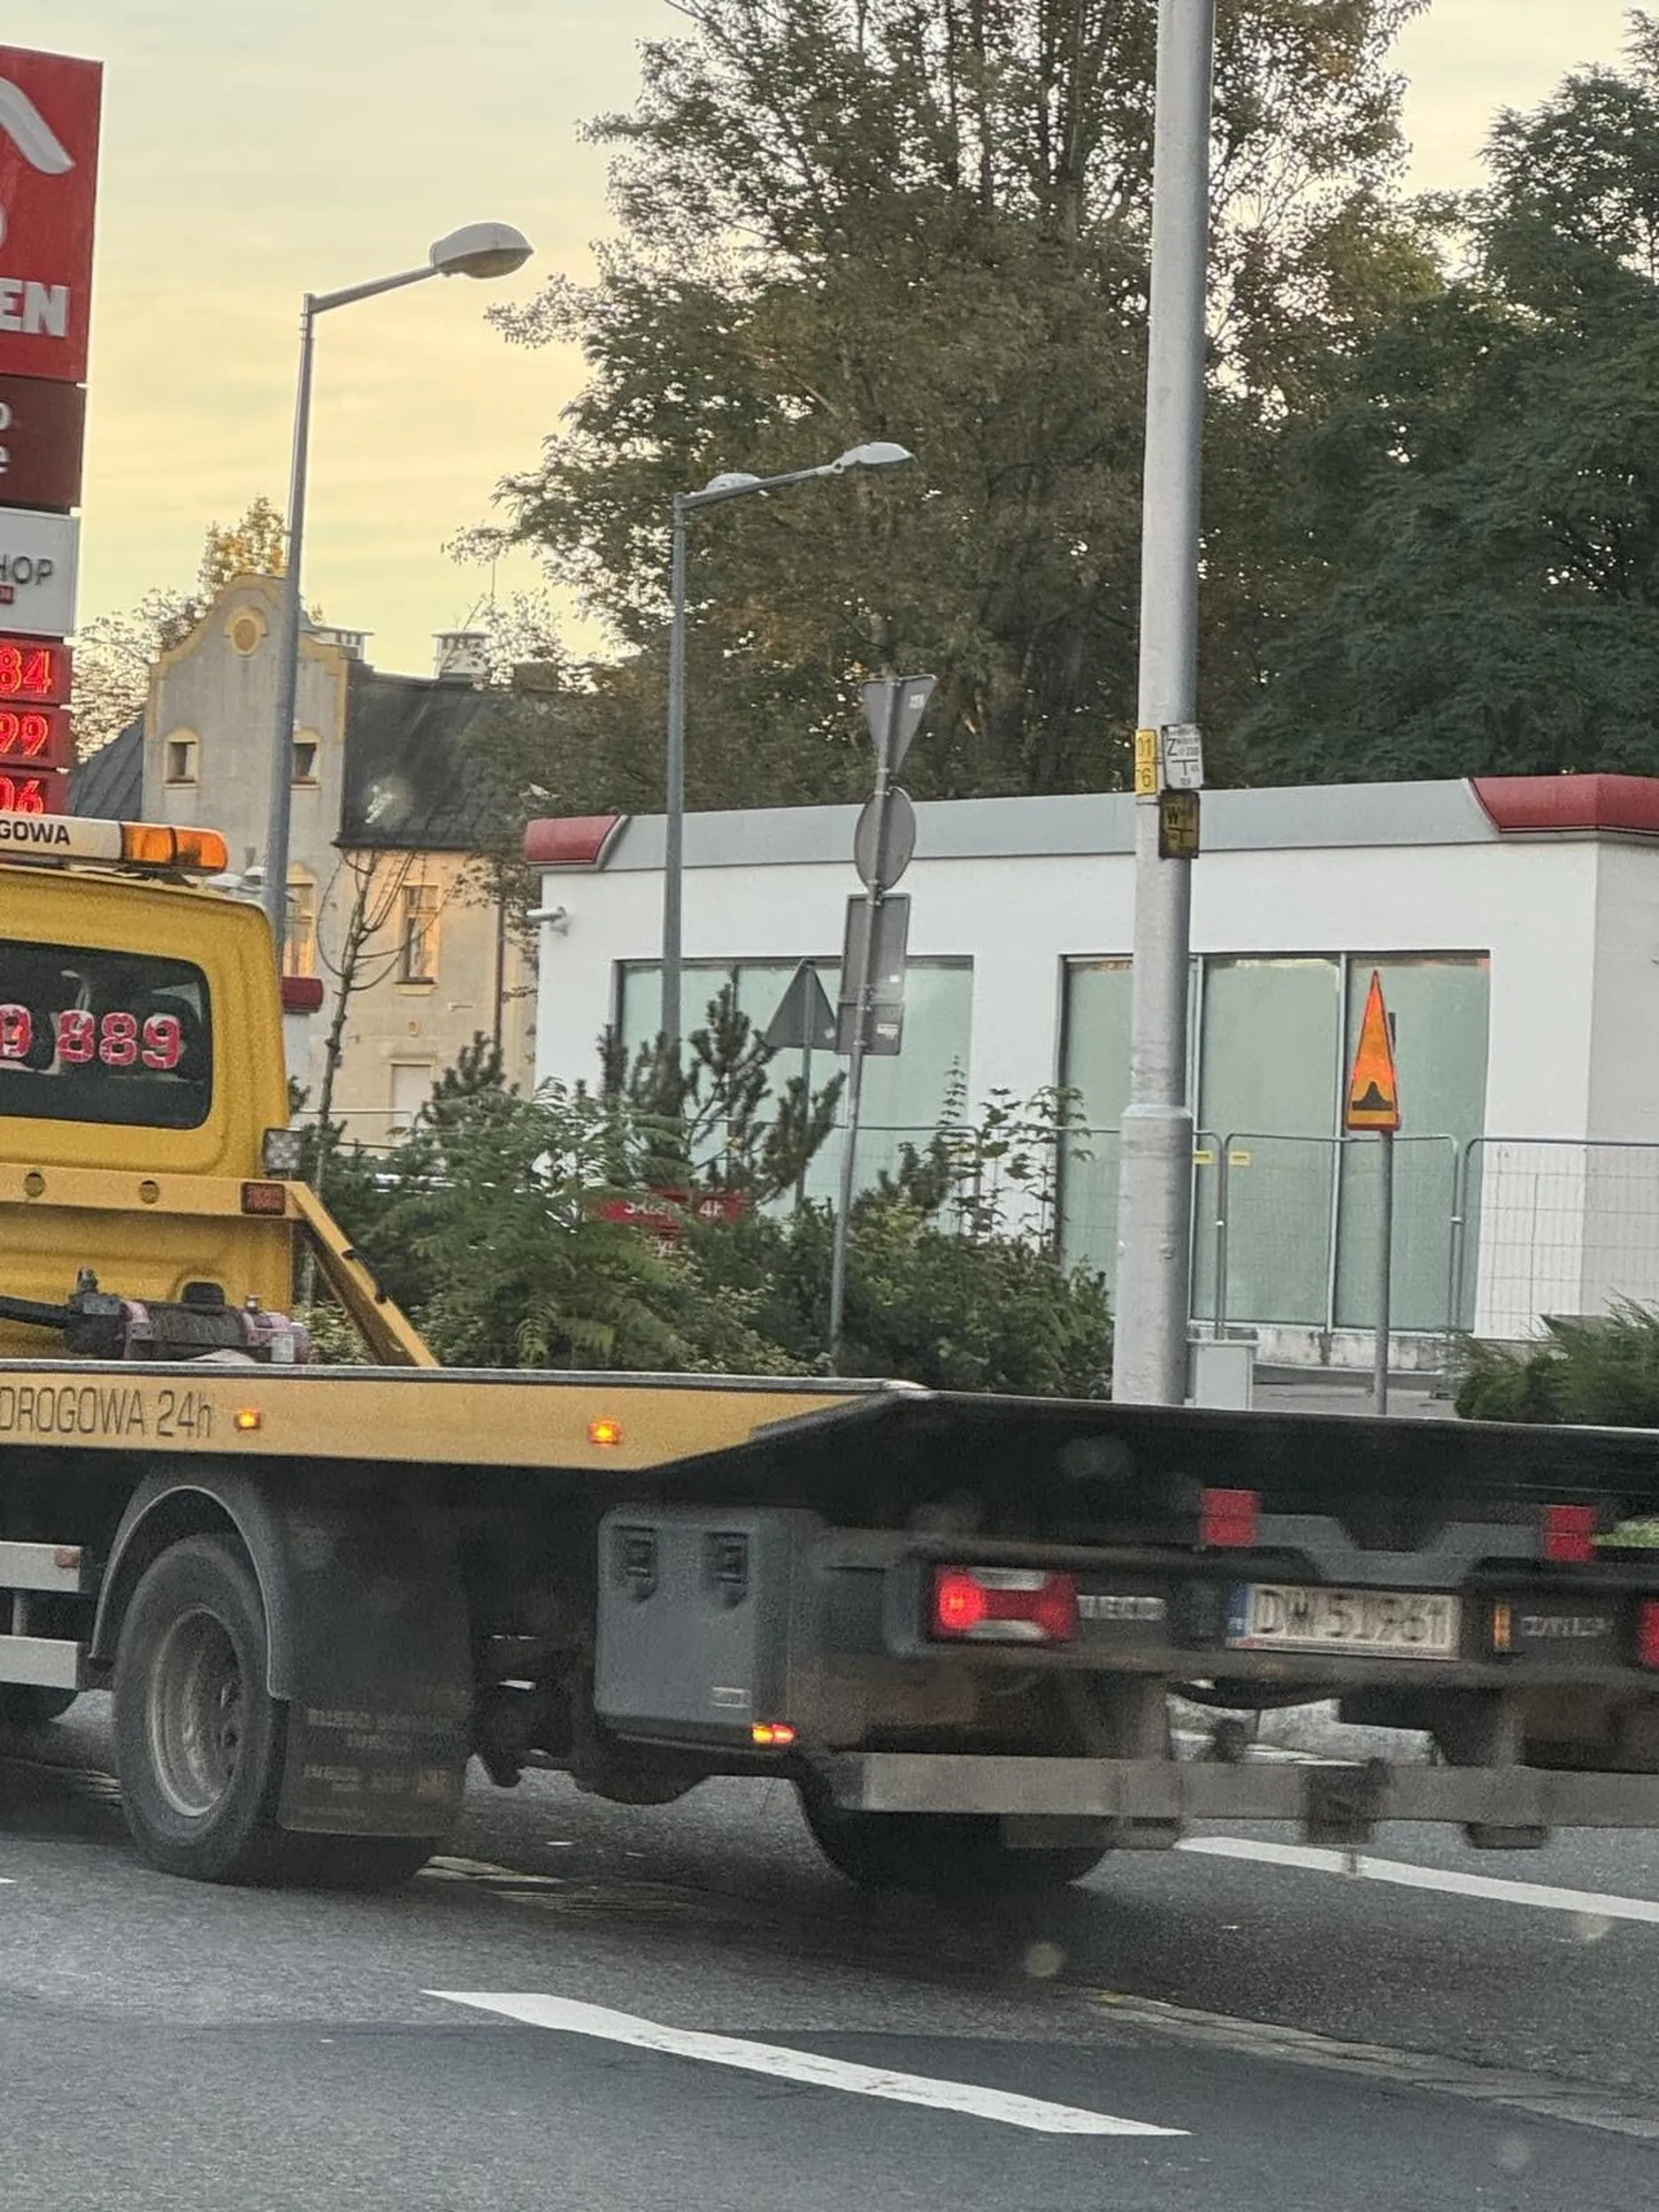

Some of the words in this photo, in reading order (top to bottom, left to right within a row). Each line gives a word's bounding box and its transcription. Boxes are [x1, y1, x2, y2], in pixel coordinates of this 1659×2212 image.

[0, 819, 70, 845] GOWA
[57, 1010, 184, 1070] 889
[0, 1386, 145, 1435] DROGOWA
[157, 1390, 211, 1439] 24h
